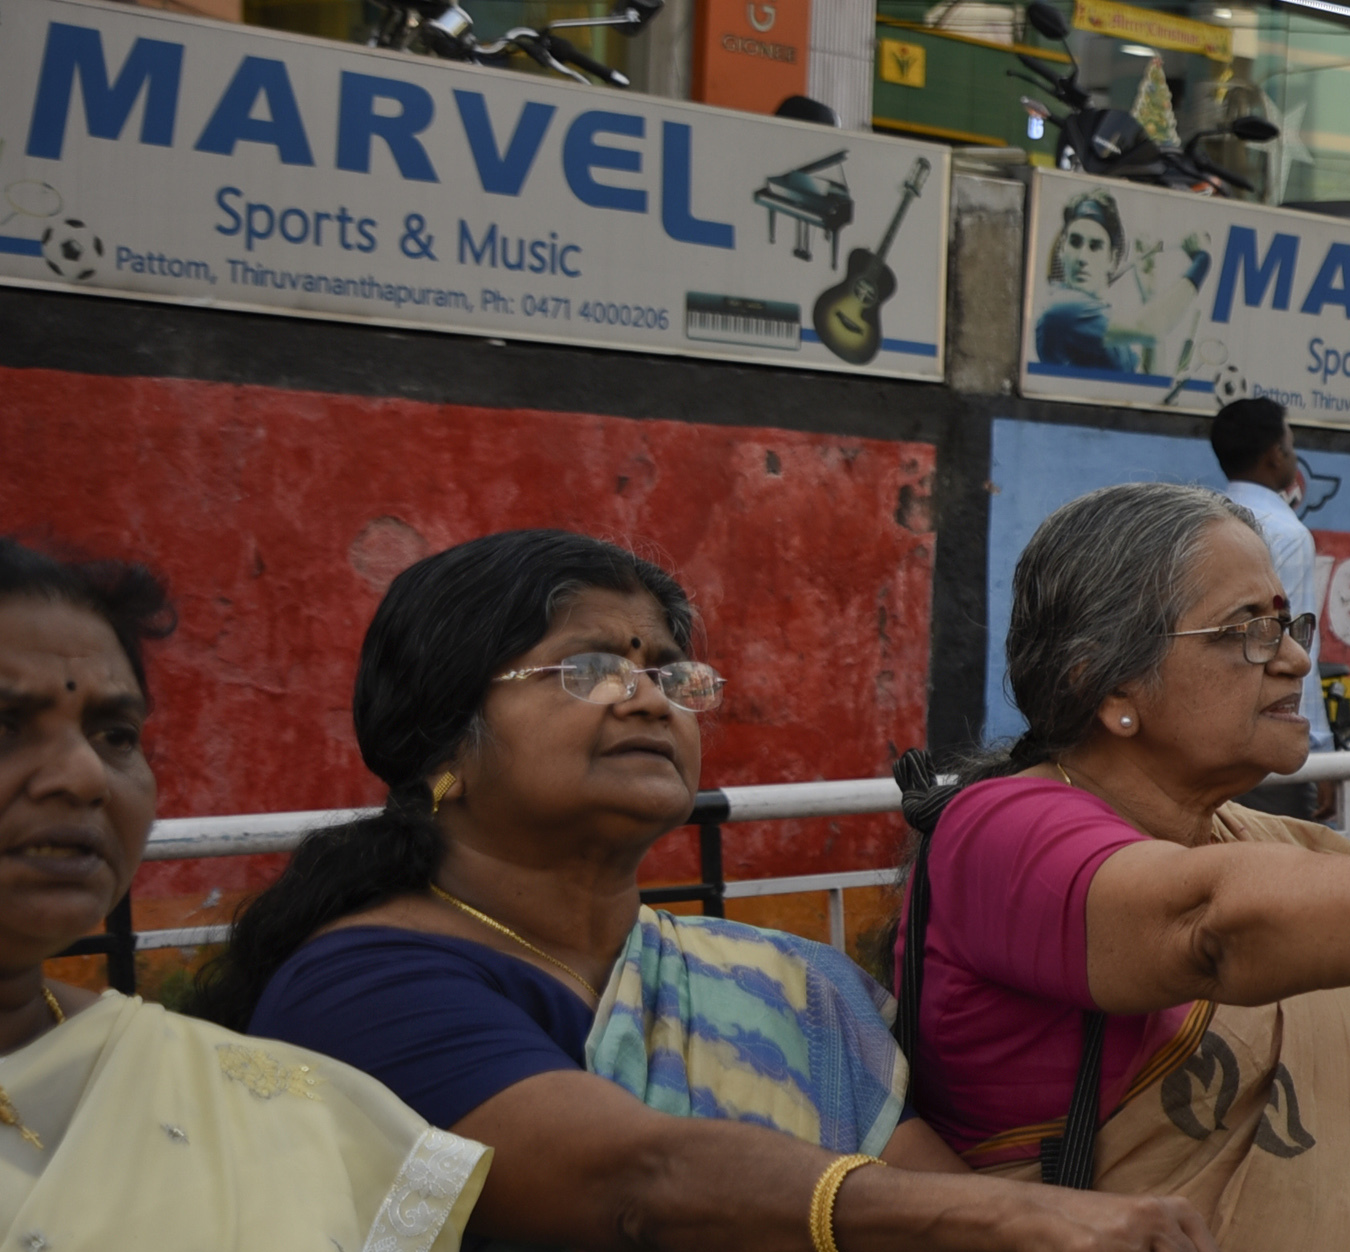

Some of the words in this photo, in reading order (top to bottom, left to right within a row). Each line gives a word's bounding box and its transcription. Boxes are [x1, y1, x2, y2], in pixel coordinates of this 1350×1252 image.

[722, 35, 797, 64] GIONEE
[27, 22, 736, 250] MARVEL
[215, 185, 378, 255] Sports
[400, 213, 436, 261] &
[457, 220, 583, 279] Music
[115, 245, 217, 285] Pattom,
[226, 257, 475, 313] Thiruvananthapuram,
[480, 288, 515, 316] Ph:
[522, 292, 573, 321] 0471
[578, 300, 670, 331] 4000206
